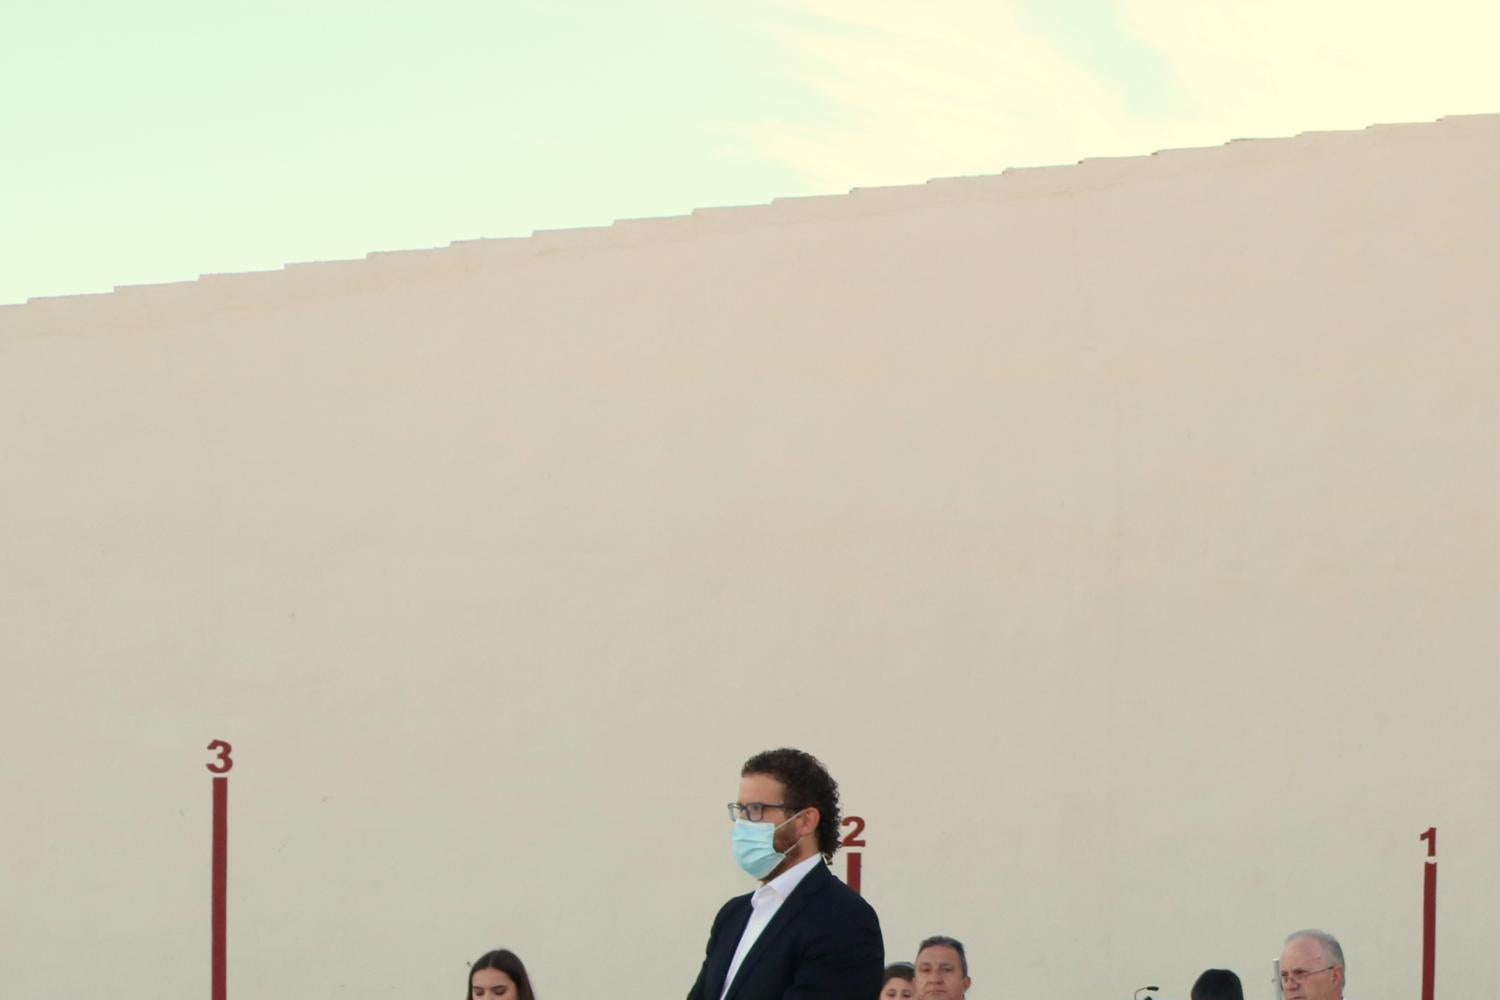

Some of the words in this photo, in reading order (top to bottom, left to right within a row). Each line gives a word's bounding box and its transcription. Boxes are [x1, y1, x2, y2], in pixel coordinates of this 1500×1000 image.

[206, 739, 233, 773] 3
[841, 816, 866, 847] 2
[1420, 827, 1437, 857] 1
